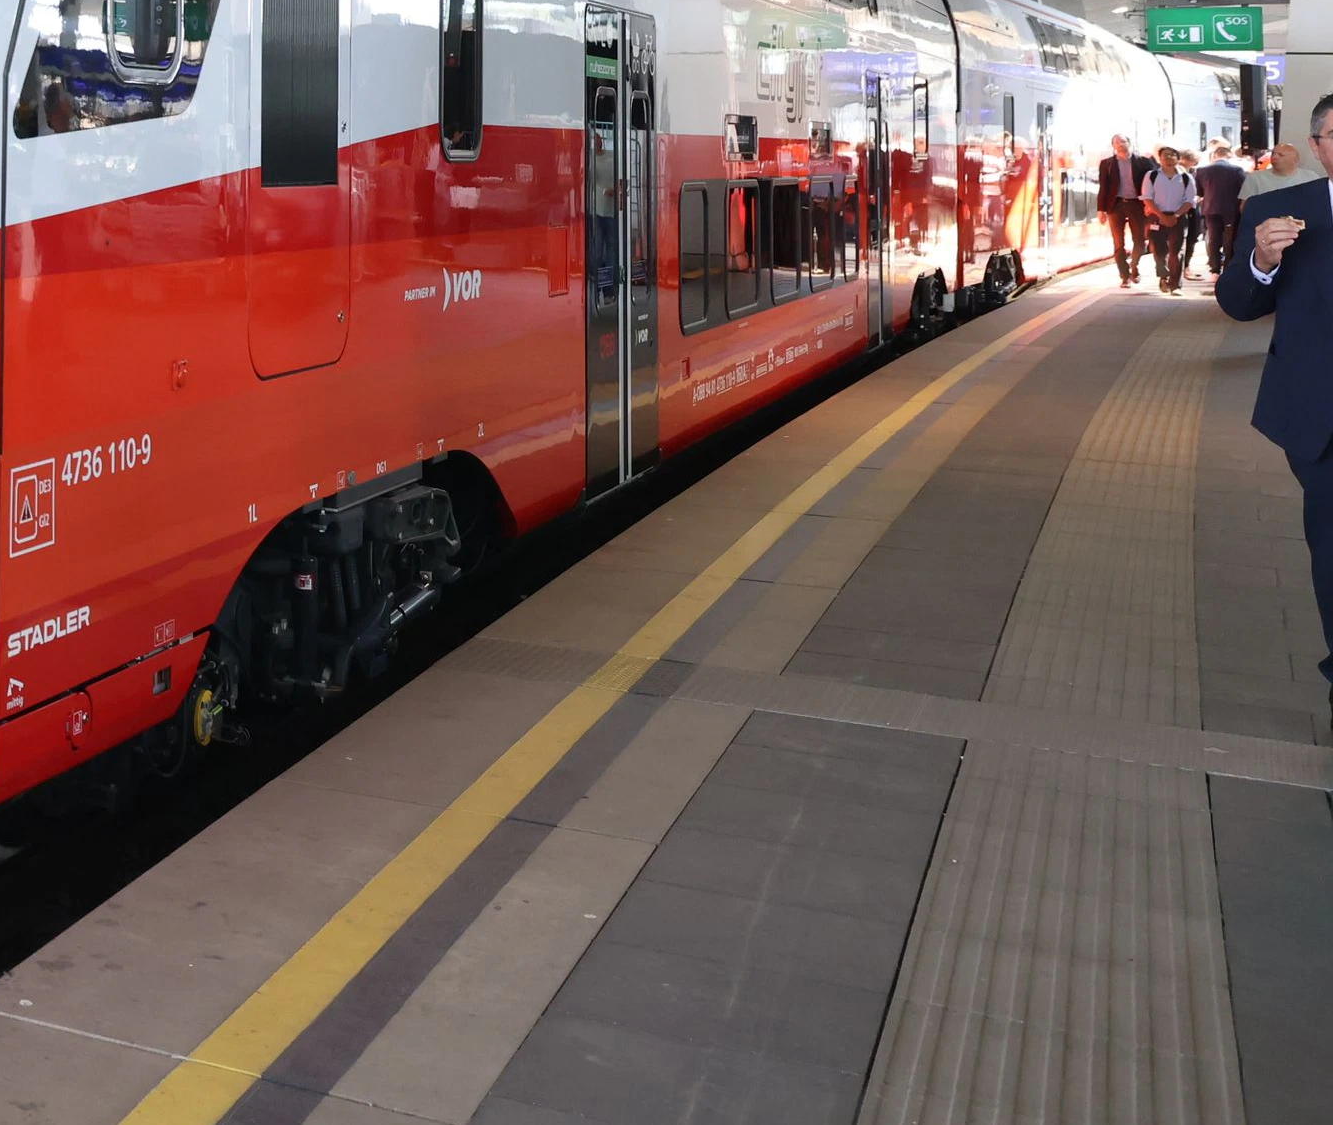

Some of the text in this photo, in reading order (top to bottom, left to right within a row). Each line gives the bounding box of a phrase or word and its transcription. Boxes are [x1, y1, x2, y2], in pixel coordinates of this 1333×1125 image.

[1225, 17, 1248, 26] SOS
[590, 61, 615, 75] ruhezone
[1266, 61, 1281, 81] 5
[404, 287, 429, 301] PARTNER
[453, 269, 482, 302] VOR
[61, 433, 151, 486] 4736 110-9
[248, 503, 258, 523] 1L
[7, 605, 91, 658] STADLER
[6, 696, 24, 710] mittig
